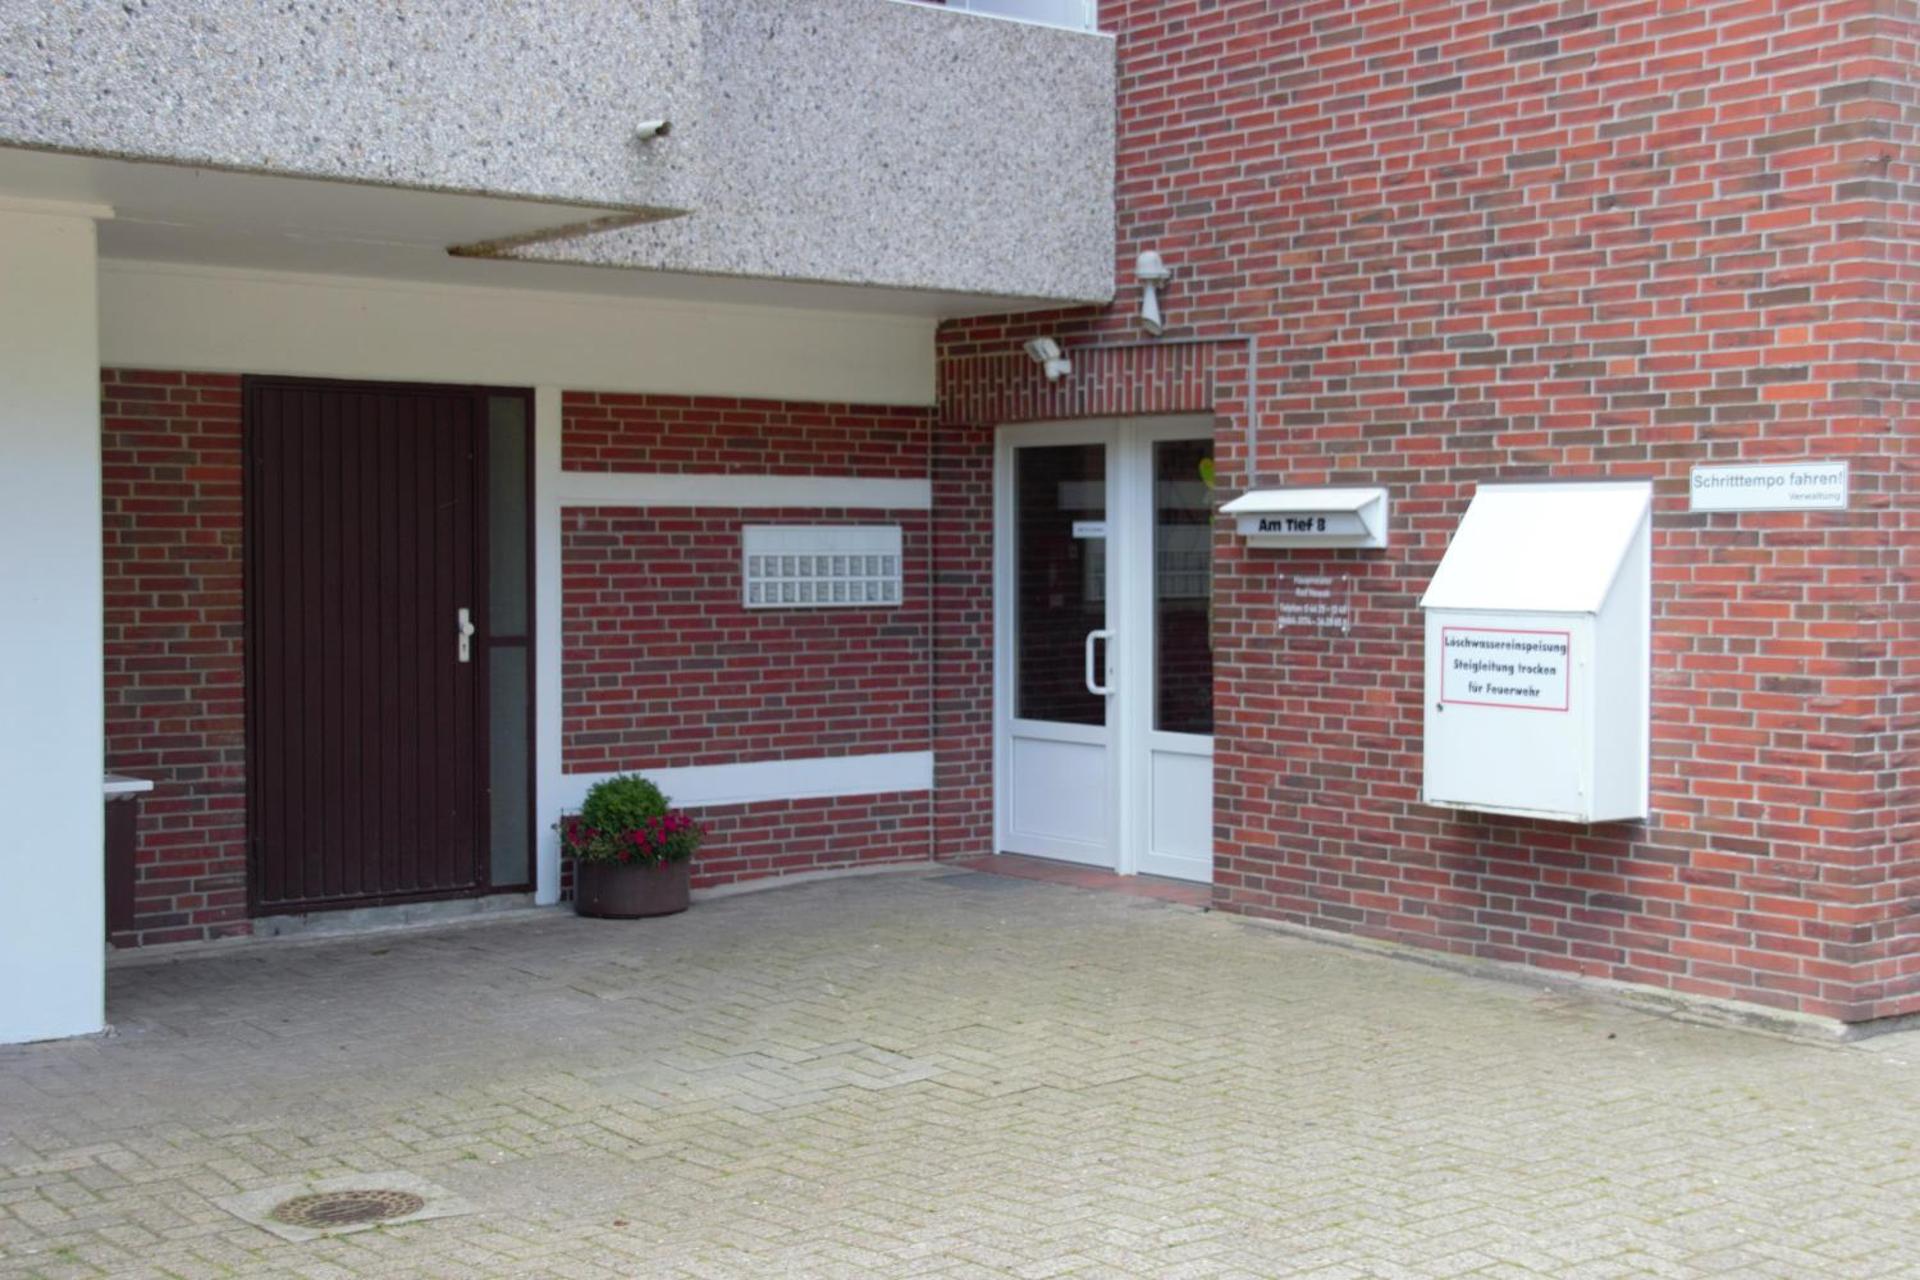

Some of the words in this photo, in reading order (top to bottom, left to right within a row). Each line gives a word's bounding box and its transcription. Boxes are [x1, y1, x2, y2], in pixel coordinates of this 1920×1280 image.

[1693, 474, 1785, 490] Schritttempo
[1790, 472, 1842, 485] fahren!
[1790, 492, 1840, 501] Verwaltung
[1259, 518, 1281, 532] Am
[1286, 518, 1313, 531] Tief
[1317, 518, 1325, 531] 8
[1445, 636, 1567, 655] Löschwassereinspeisung
[1454, 659, 1514, 675] Steigleitung
[1518, 663, 1556, 675] trocken
[1468, 681, 1482, 693] für
[1486, 683, 1540, 696] Feuerwehr
